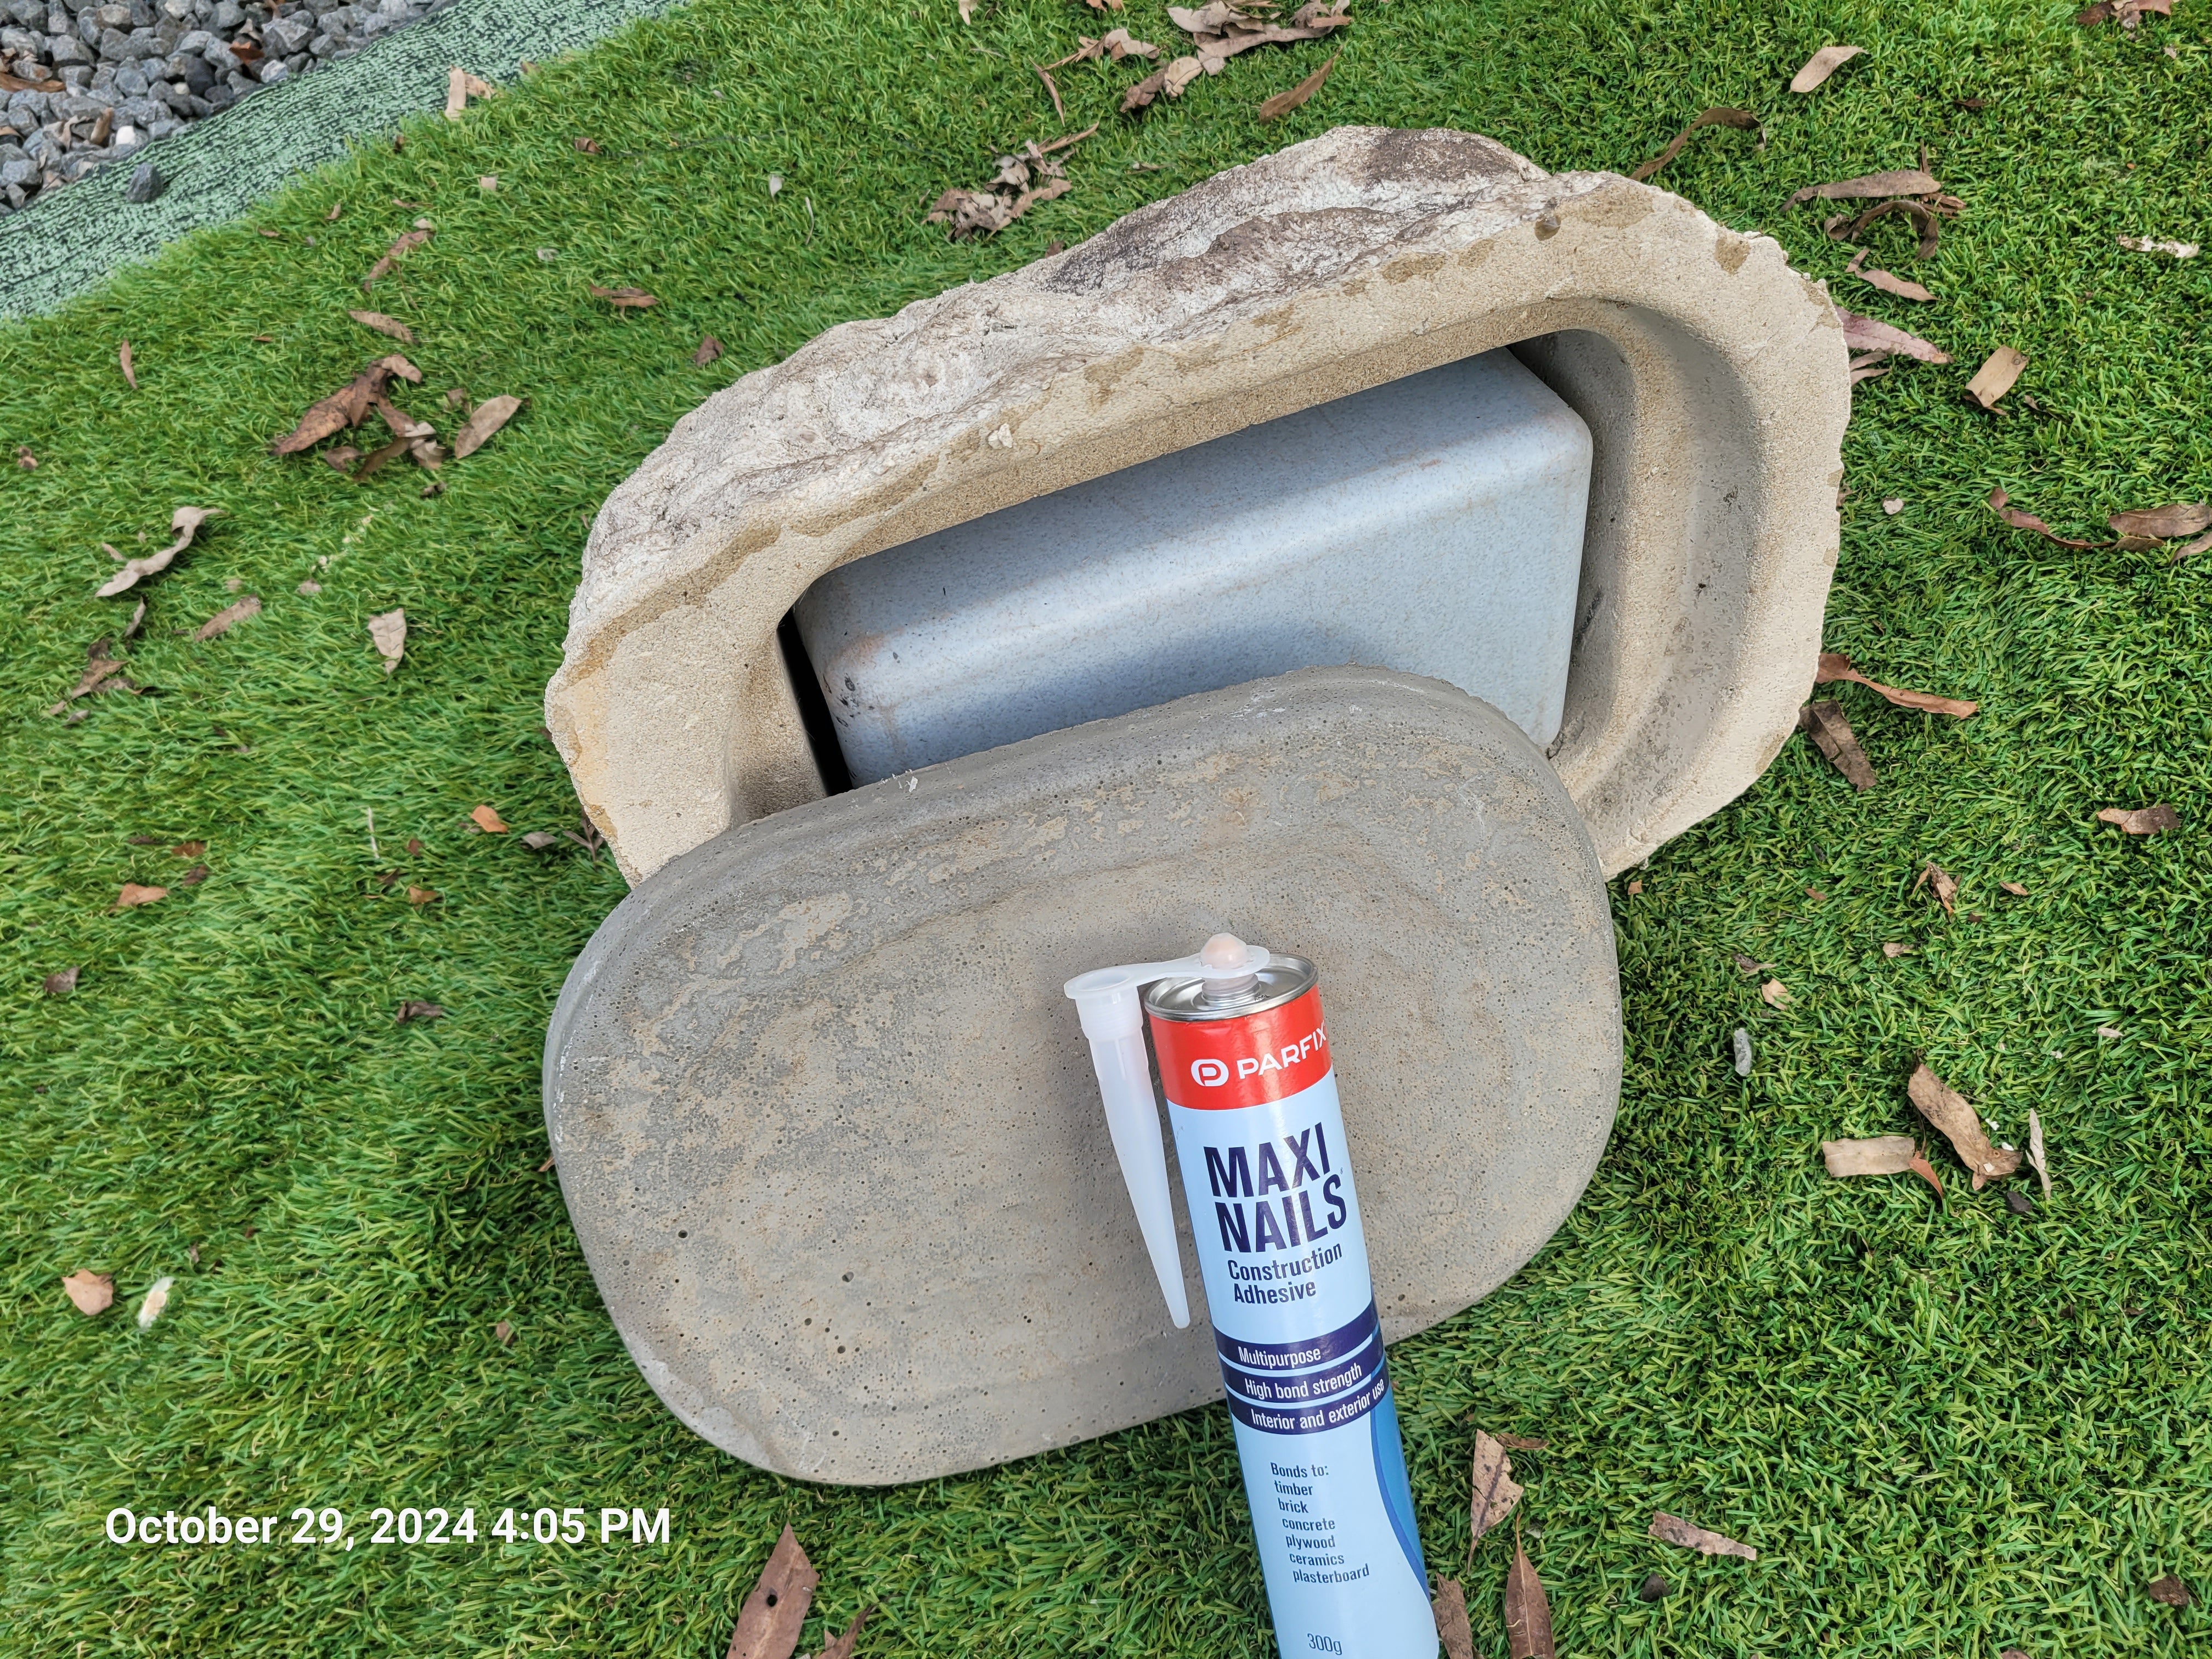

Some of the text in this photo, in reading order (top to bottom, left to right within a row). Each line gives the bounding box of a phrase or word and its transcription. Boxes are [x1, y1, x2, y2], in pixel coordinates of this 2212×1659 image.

[1237, 1020, 1327, 1079] PARFIX
[1204, 1122, 1330, 1197] MAXI
[1214, 1173, 1347, 1252] NAILS
[1227, 1243, 1342, 1280] Construction
[1234, 1283, 1316, 1304] Adhesive
[1238, 1346, 1321, 1369] Multipurpose
[1245, 1363, 1362, 1401] High bond strength
[1251, 1378, 1385, 1429] Interior and exterior use
[1271, 1462, 1328, 1478] Bonds to:
[1274, 1480, 1312, 1496] timber
[1278, 1498, 1308, 1514] brick
[1282, 1517, 1335, 1531] concrete
[1286, 1534, 1335, 1550] plywood
[1289, 1552, 1344, 1565] ceramics
[1293, 1564, 1369, 1584] plasterboard
[1307, 1633, 1342, 1655] 300g
